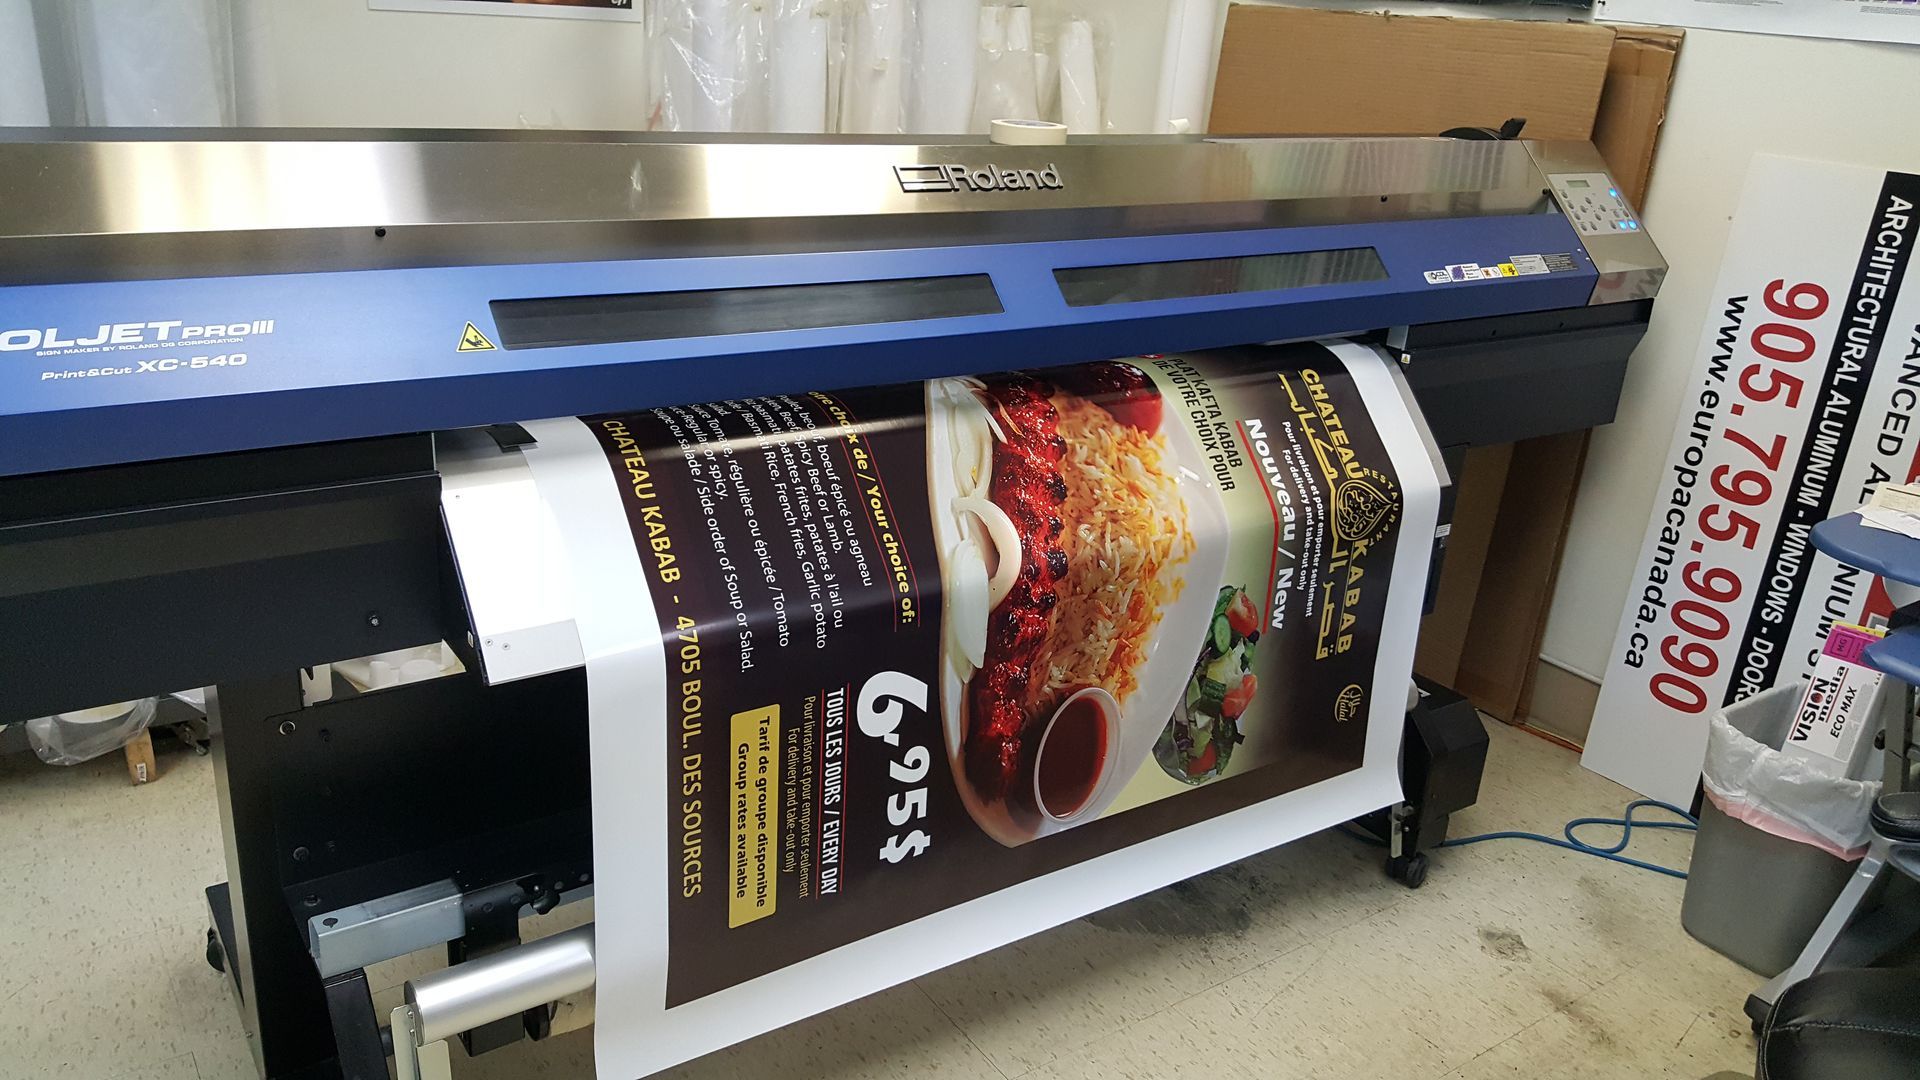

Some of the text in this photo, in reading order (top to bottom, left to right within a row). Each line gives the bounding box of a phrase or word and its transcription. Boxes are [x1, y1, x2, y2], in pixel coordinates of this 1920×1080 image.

[945, 163, 1064, 192] Roland
[1832, 195, 1913, 385] ARCHITECTURAL
[41, 353, 248, 381] Print&Cut XC-540
[64, 347, 100, 355] MAKER
[118, 342, 160, 351] ROLAND
[177, 337, 244, 347] CORPORATION
[670, 425, 684, 437] ou
[741, 412, 772, 449] Basmati
[1152, 360, 1235, 492] DE VOTRE CHOIX POUR
[1168, 358, 1243, 468] PLAT KAFTA KABAB
[602, 420, 656, 500] CHATEAU
[678, 437, 702, 477] salade
[703, 450, 717, 462] or
[763, 451, 780, 481] Rice,
[776, 440, 801, 484] patates
[794, 434, 813, 466] Spicy
[1797, 389, 1850, 510] ALUMINUM
[697, 487, 715, 515] Side
[708, 464, 729, 500] spicy.
[727, 459, 754, 517] régulière
[794, 486, 813, 521] frites,
[807, 467, 827, 497] Beef
[1624, 296, 1749, 669] www.europacanada.ca
[1649, 279, 1830, 713] 905.795.9090
[775, 482, 798, 527] French
[807, 390, 833, 406] otre
[829, 406, 859, 444] choix
[852, 447, 868, 470] de
[866, 485, 890, 529] Your
[883, 532, 910, 593] choice
[901, 597, 916, 625] of:
[817, 498, 828, 513] or
[817, 443, 841, 484] boeuf
[830, 484, 852, 517] épicé
[843, 518, 855, 536] ou
[849, 538, 873, 587] agneau
[1245, 418, 1296, 541] Nouveau
[1271, 567, 1294, 630] New
[1282, 421, 1324, 618] Pour livraison et pour emporter seulement
[1282, 449, 1315, 591] For delivery and take-out only
[1302, 368, 1364, 479] CHATEAU
[1337, 538, 1369, 654] KABAB
[1363, 467, 1399, 547] RESTAURANT
[641, 506, 681, 583] KABAB
[707, 519, 726, 554] order
[748, 519, 761, 537] ou
[790, 529, 807, 559] fries,
[804, 523, 831, 570] patates
[822, 512, 844, 554] Lamb.
[719, 557, 736, 571] of
[754, 540, 777, 583] épicée
[801, 561, 821, 600] Garlic
[824, 573, 836, 581] à
[1761, 522, 1811, 625] WINDOWS
[724, 573, 743, 610] Soup
[827, 583, 844, 607] l'ail
[736, 612, 749, 627] or
[773, 593, 789, 647] Tomato
[810, 603, 827, 649] potato
[833, 609, 843, 628] ou
[676, 616, 701, 674] 4705
[739, 630, 754, 673] Salad.
[682, 679, 702, 749] BOUL.
[826, 687, 844, 728] TOUS
[1339, 690, 1350, 721] Halal
[1792, 677, 1830, 741] VISION
[1818, 665, 1846, 722] media
[1830, 685, 1858, 739] ECO MAX
[825, 730, 843, 758] LES
[682, 754, 702, 796] DES
[798, 695, 816, 899] Pour livraison et pour emporter seulement
[824, 761, 842, 806] JOURS
[735, 742, 749, 899] Group rates available
[754, 715, 770, 907] Tarif de groupe disponible
[782, 727, 800, 873] For delivery and take-out only
[682, 800, 702, 898] SOURCES
[822, 819, 840, 865] EVERY
[821, 867, 838, 895] DAY
